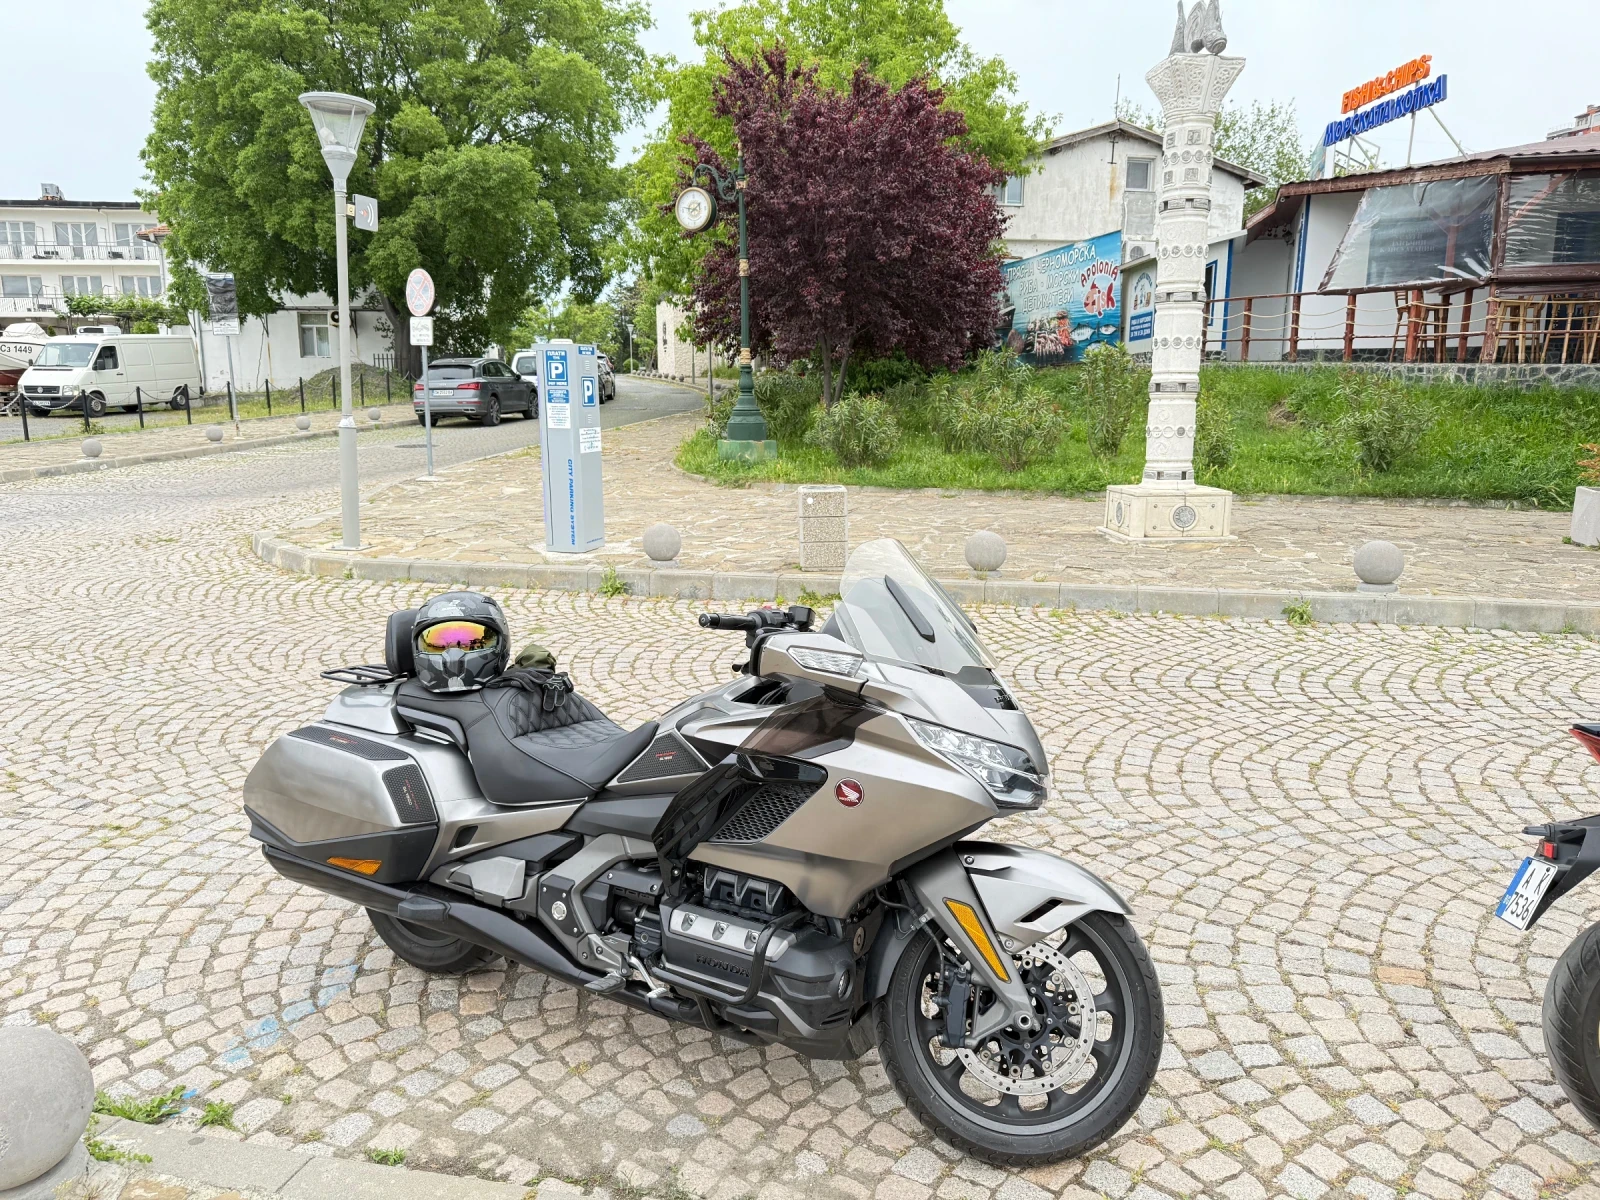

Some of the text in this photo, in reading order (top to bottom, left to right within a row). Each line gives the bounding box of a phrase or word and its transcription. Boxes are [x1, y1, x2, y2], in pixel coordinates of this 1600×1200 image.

[1323, 74, 1447, 147] МОРСКАТА КОТКА
[1007, 244, 1096, 282] ПРЯСНА ЧЕРНОМОРСКА
[1019, 279, 1038, 296] РИБА
[1046, 268, 1080, 290] МОРСКИ
[1022, 287, 1075, 315] ДЕЛИКАТЕСИ
[13, 345, 33, 354] 1449
[551, 362, 563, 379] P
[583, 380, 593, 403] P
[1521, 868, 1550, 896] A K
[1505, 891, 1535, 921] 7536
[696, 953, 750, 978] HONDA
